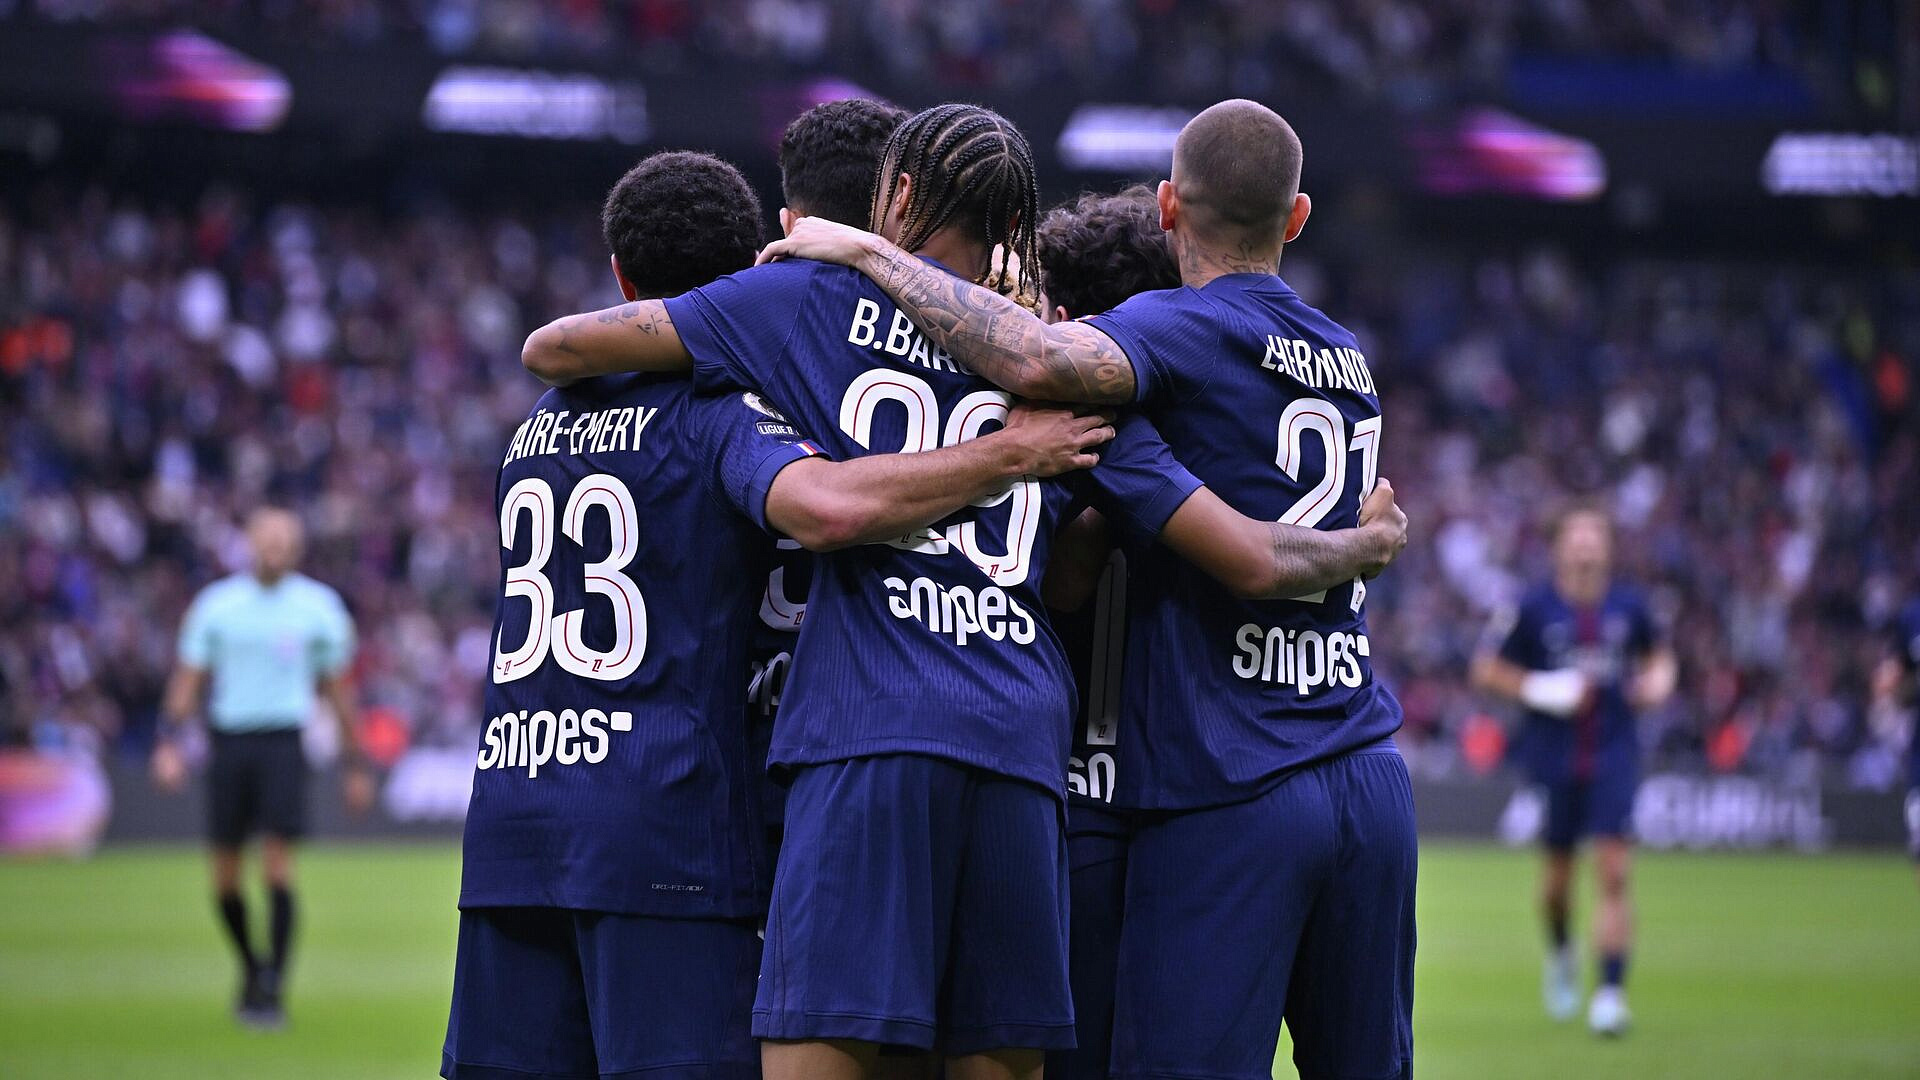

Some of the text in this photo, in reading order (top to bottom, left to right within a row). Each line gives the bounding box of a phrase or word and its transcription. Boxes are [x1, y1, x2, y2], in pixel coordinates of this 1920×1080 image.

[847, 297, 978, 376] B.BAR
[493, 473, 647, 684] 33
[882, 576, 1036, 646] snipes
[1232, 623, 1363, 695] snipes
[477, 708, 610, 778] snipes
